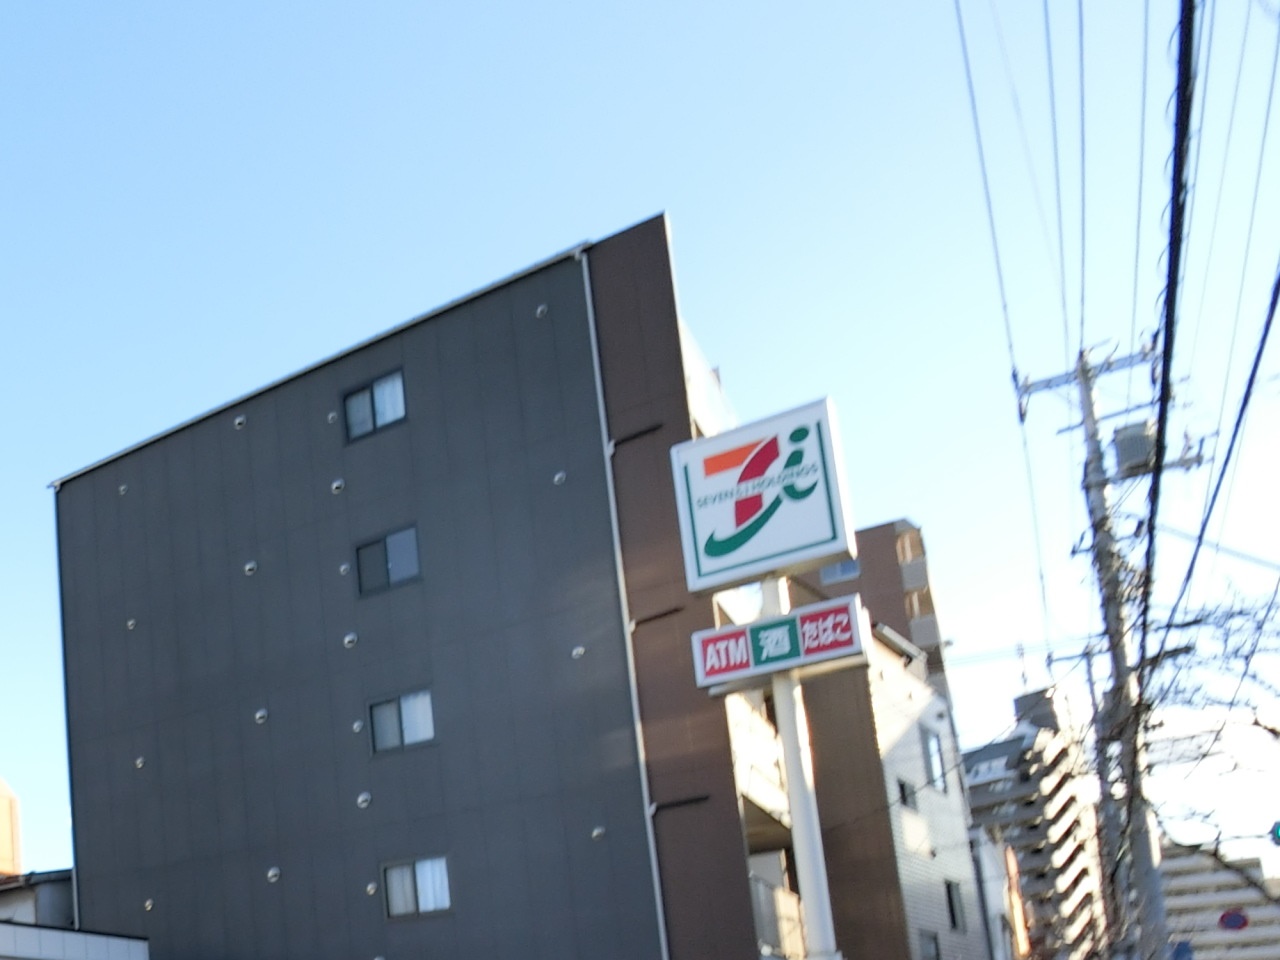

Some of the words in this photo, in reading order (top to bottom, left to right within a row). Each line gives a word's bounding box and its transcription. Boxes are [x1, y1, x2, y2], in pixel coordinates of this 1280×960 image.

[758, 625, 790, 661] 酒
[801, 612, 852, 648] たばこ
[704, 636, 748, 671] ATM
